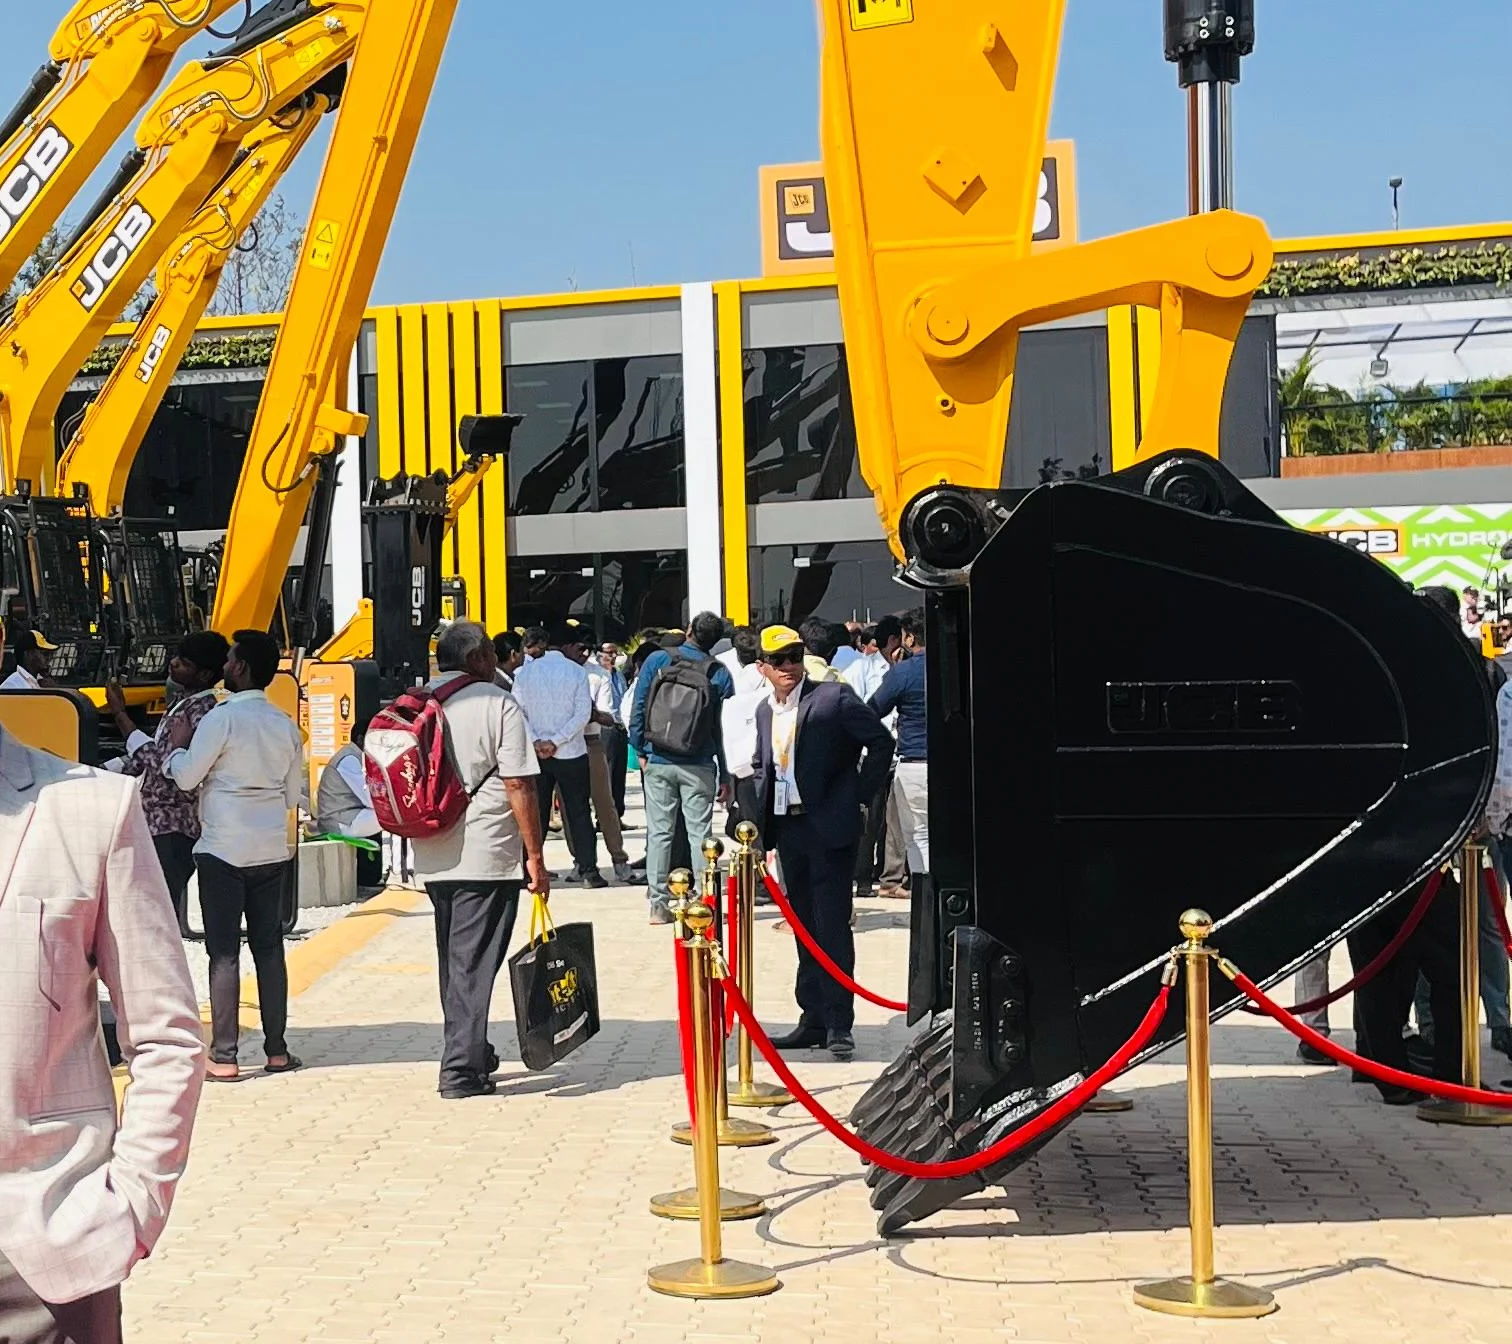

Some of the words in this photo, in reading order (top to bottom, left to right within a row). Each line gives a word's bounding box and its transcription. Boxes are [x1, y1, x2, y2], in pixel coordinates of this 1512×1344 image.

[81, 204, 152, 307] JCB
[139, 325, 172, 384] JCB
[1328, 529, 1398, 554] CB
[1412, 529, 1512, 549] HYDRO
[412, 567, 422, 626] JCB
